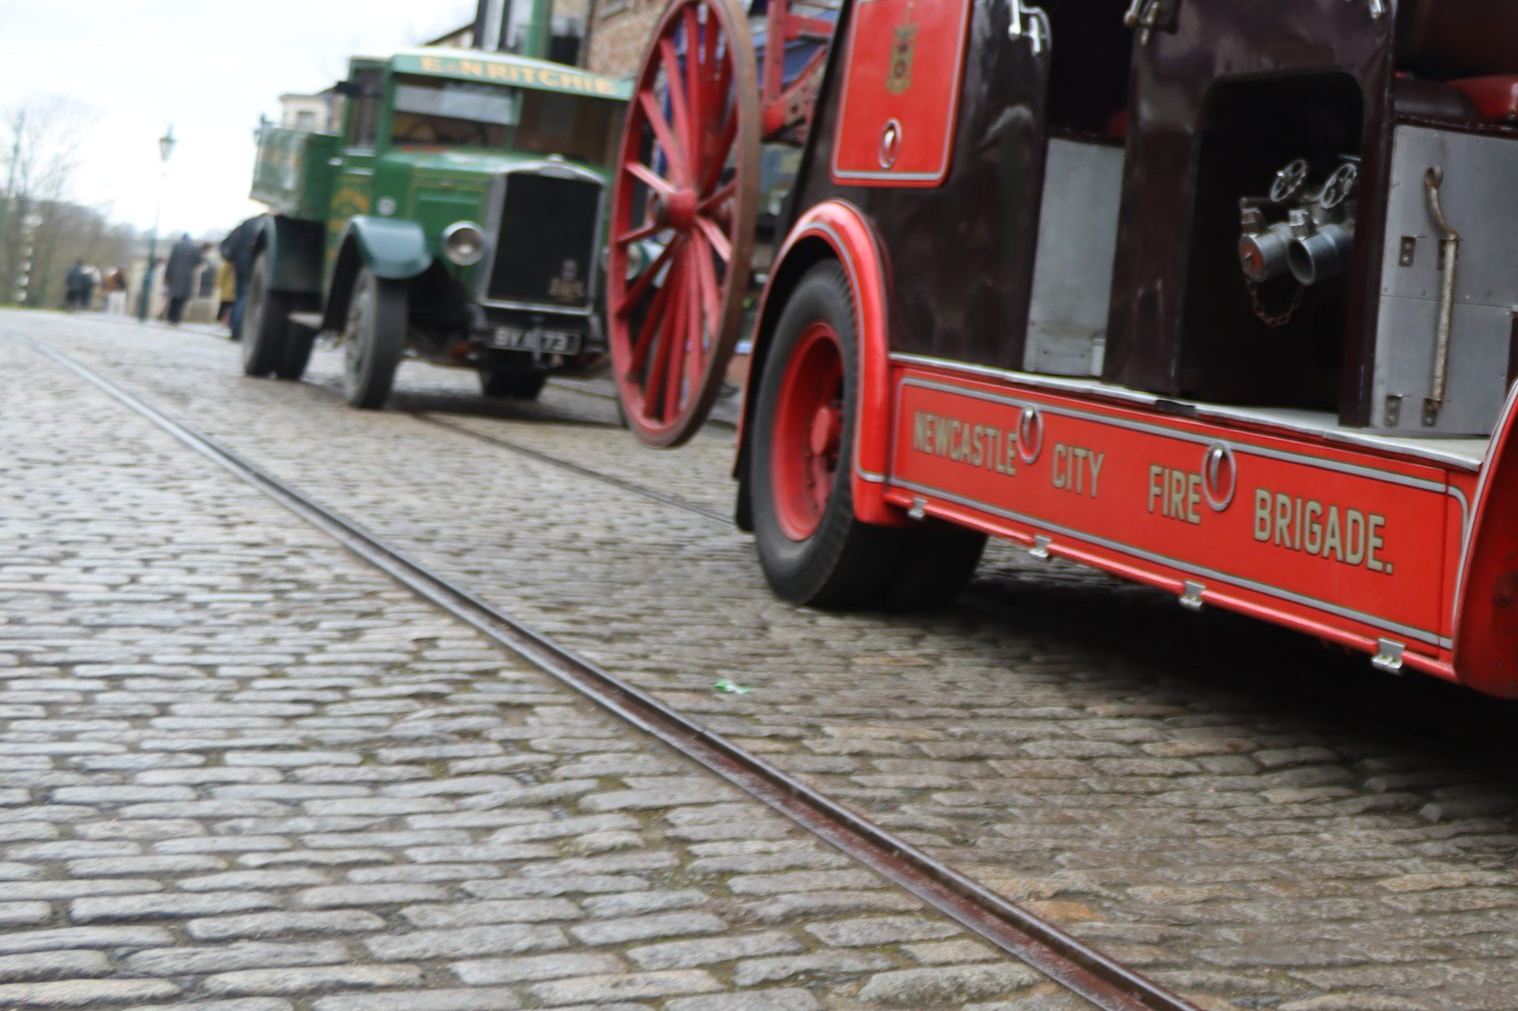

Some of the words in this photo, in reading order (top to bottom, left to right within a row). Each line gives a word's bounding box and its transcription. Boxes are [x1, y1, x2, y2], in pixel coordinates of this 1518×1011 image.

[486, 62, 617, 96] RITCHIE
[913, 411, 1018, 477] NEWCASTLE
[1052, 443, 1105, 498] CITY
[1147, 464, 1202, 525] FIRE
[1253, 487, 1394, 575] BRIGADE.
